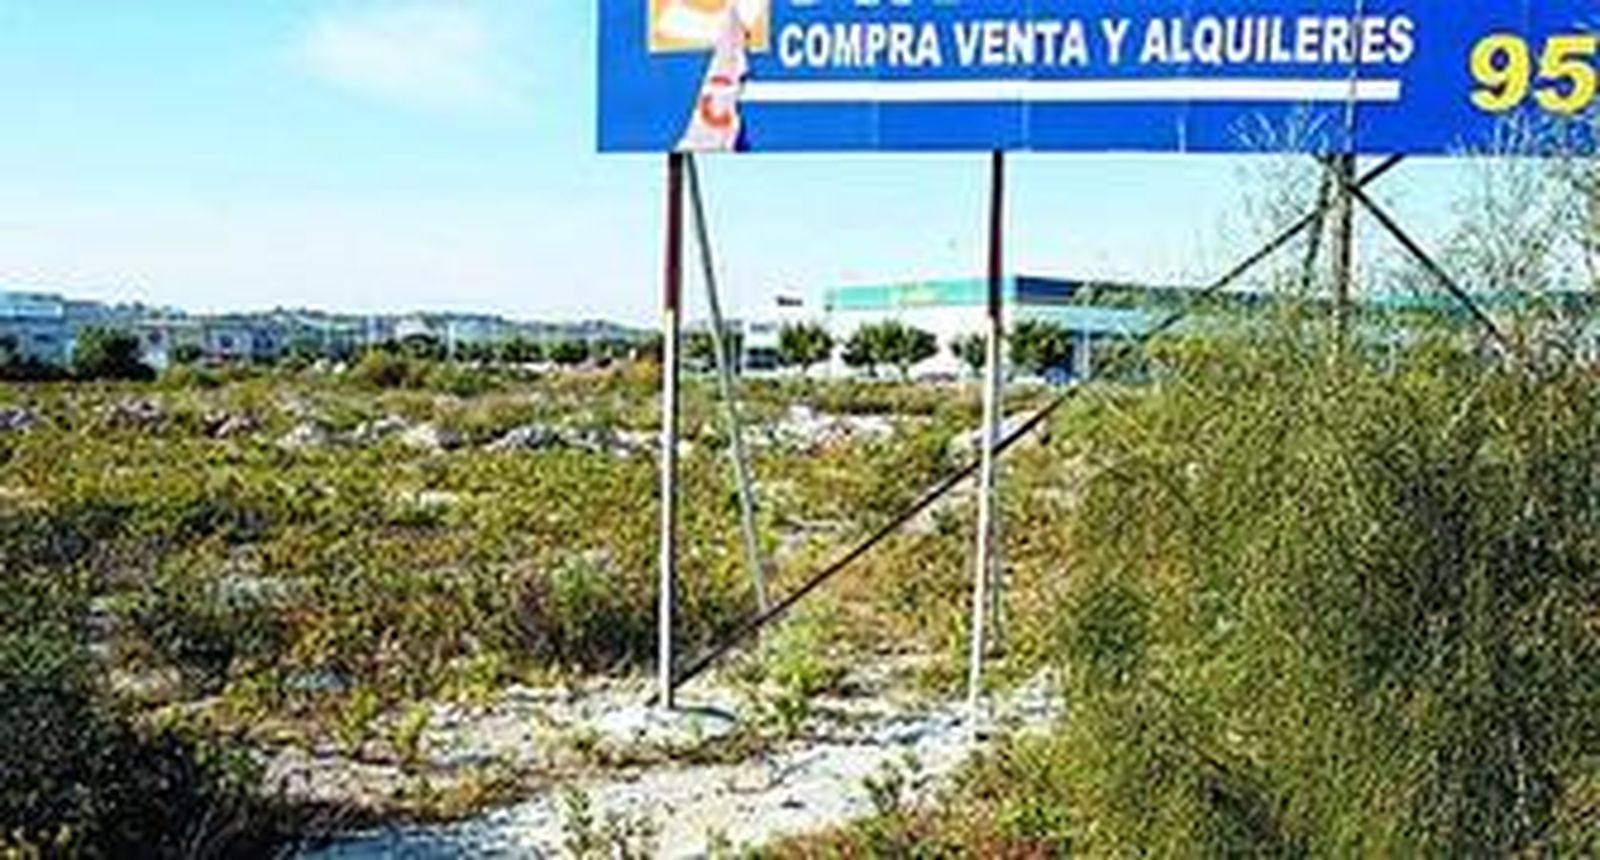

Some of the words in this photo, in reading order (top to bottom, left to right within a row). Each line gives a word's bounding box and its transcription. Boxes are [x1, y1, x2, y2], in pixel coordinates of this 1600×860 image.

[779, 23, 942, 67] COMPRA
[954, 21, 1088, 65] VENTA
[1103, 20, 1129, 64] Y
[1140, 16, 1414, 64] ALQUILERES
[1469, 34, 1597, 114] 95
